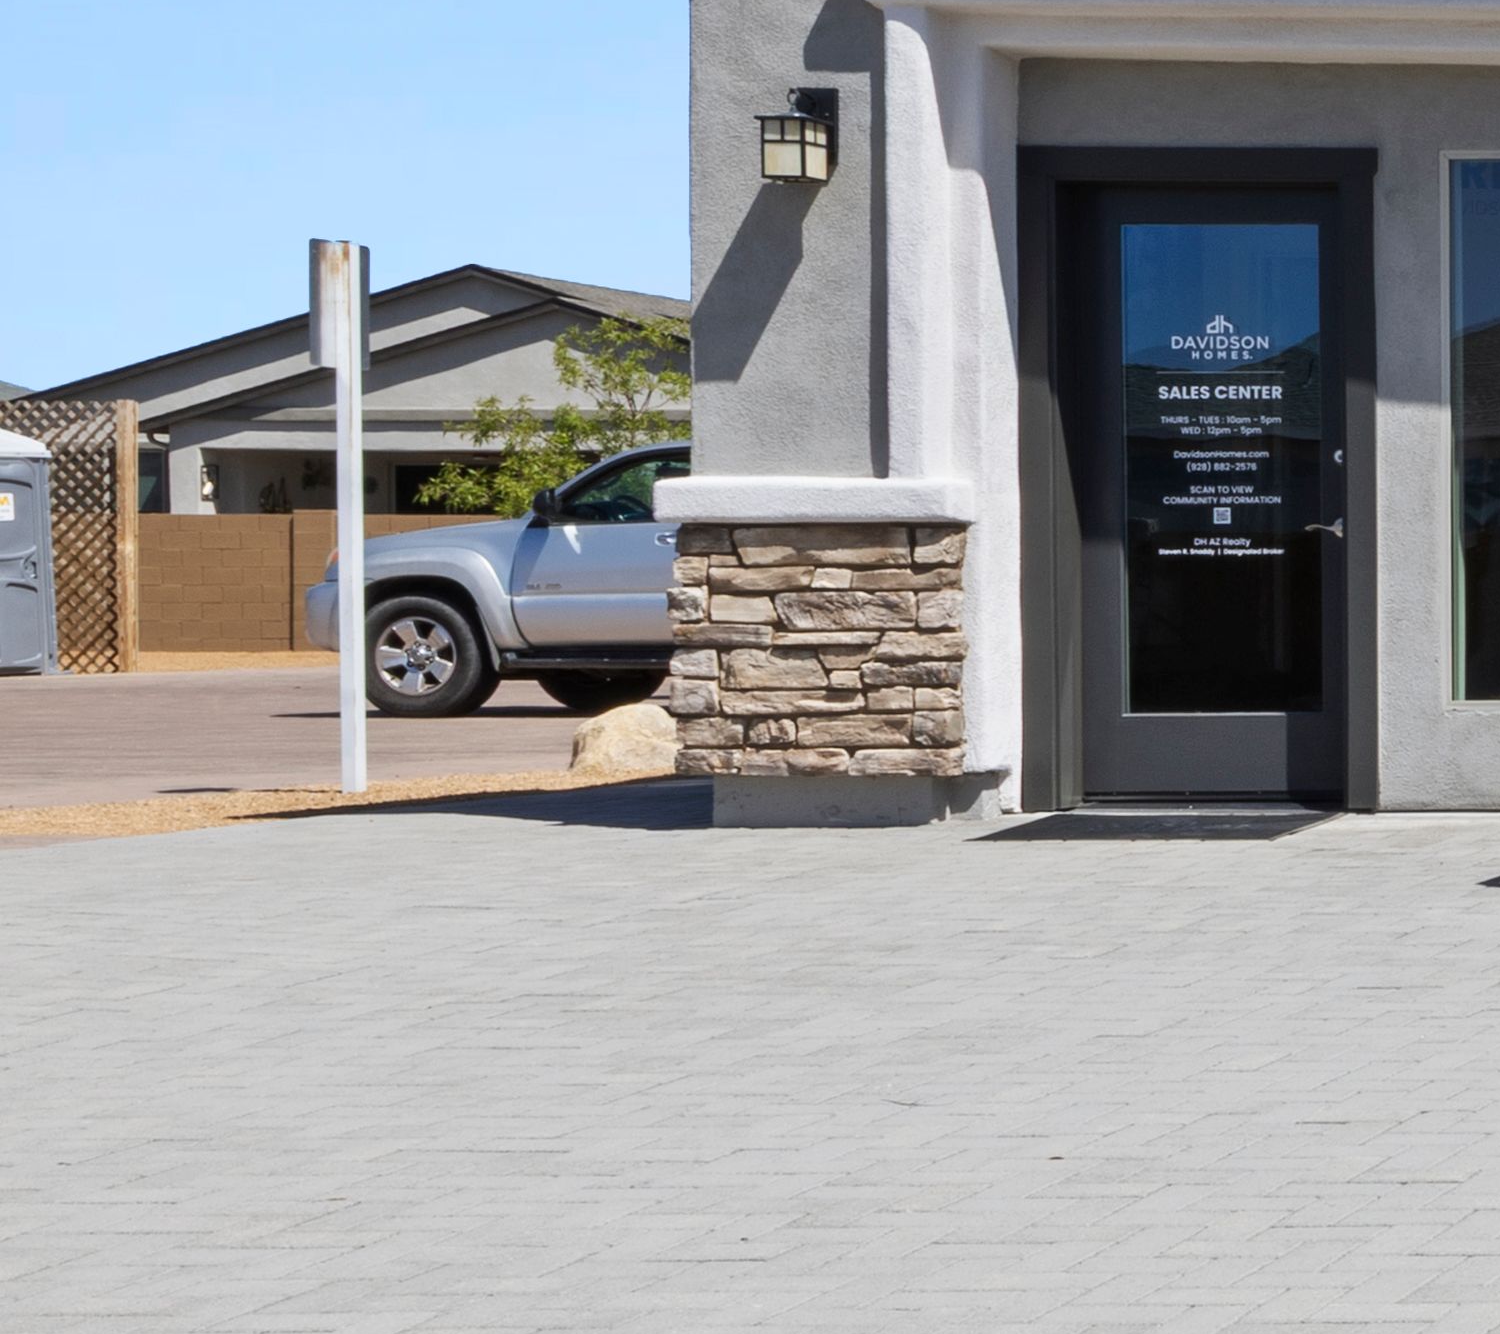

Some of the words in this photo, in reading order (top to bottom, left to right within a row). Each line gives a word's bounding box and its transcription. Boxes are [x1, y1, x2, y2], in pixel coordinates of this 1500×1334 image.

[1170, 335, 1270, 349] DAVIDSON
[1158, 385, 1211, 400] SALES
[1214, 385, 1284, 400] CENTER
[1160, 415, 1190, 424] THURS
[1199, 415, 1221, 424] TUES
[1226, 415, 1252, 424] 10am
[1260, 415, 1283, 426] 5pm
[1180, 426, 1201, 435] WED
[1207, 426, 1232, 437] 12pm
[1240, 426, 1263, 437] 5pm
[1173, 450, 1270, 459] DavidsonHomes.com
[1189, 485, 1216, 495] SCAN
[1217, 485, 1230, 495] TO
[1230, 485, 1255, 495] VIEW
[1162, 495, 1218, 505] COMMUNITY
[1219, 495, 1282, 505] INFORMATION
[1193, 537, 1208, 546] DH
[1208, 537, 1221, 546] AZ
[1222, 537, 1252, 548] Realty
[1222, 548, 1262, 557] Designated
[1262, 548, 1286, 556] Broker
